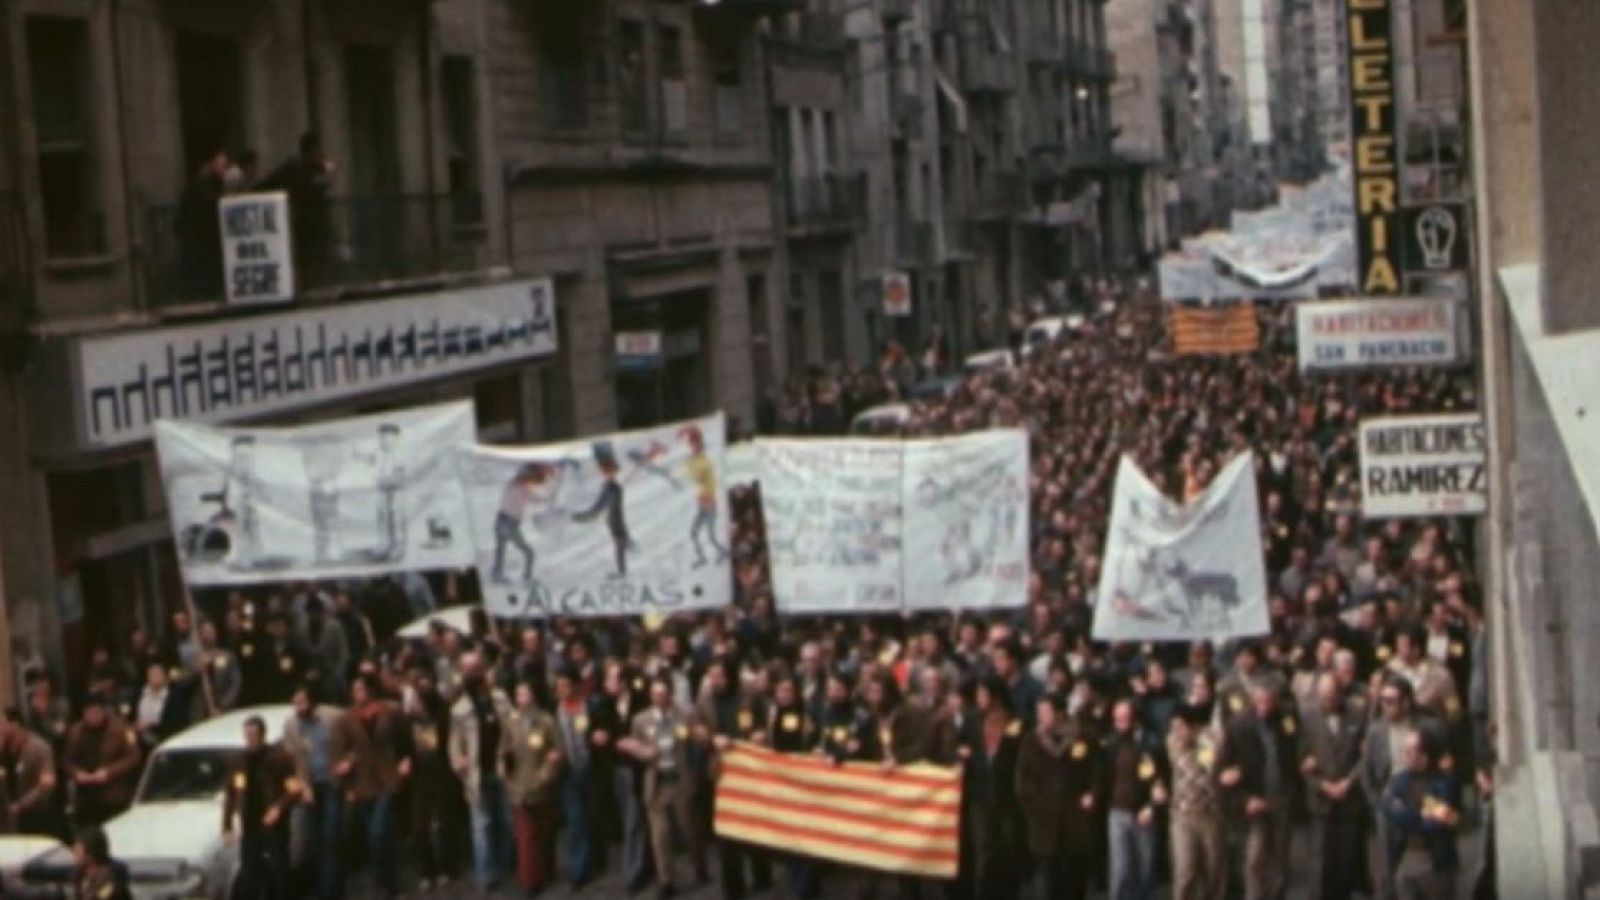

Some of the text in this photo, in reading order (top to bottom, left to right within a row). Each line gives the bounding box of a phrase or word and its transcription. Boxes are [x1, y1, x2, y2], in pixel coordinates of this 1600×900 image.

[1350, 0, 1399, 294] LETERIA
[225, 202, 278, 238] HOSTAL
[237, 242, 268, 260] DEL
[233, 263, 280, 299] SEGRE
[1312, 311, 1447, 334] HABITACIONES
[1314, 339, 1446, 360] SAN PANCRACIO
[1367, 424, 1485, 454] HABITACIONES
[1368, 462, 1485, 497] RAMIREZ
